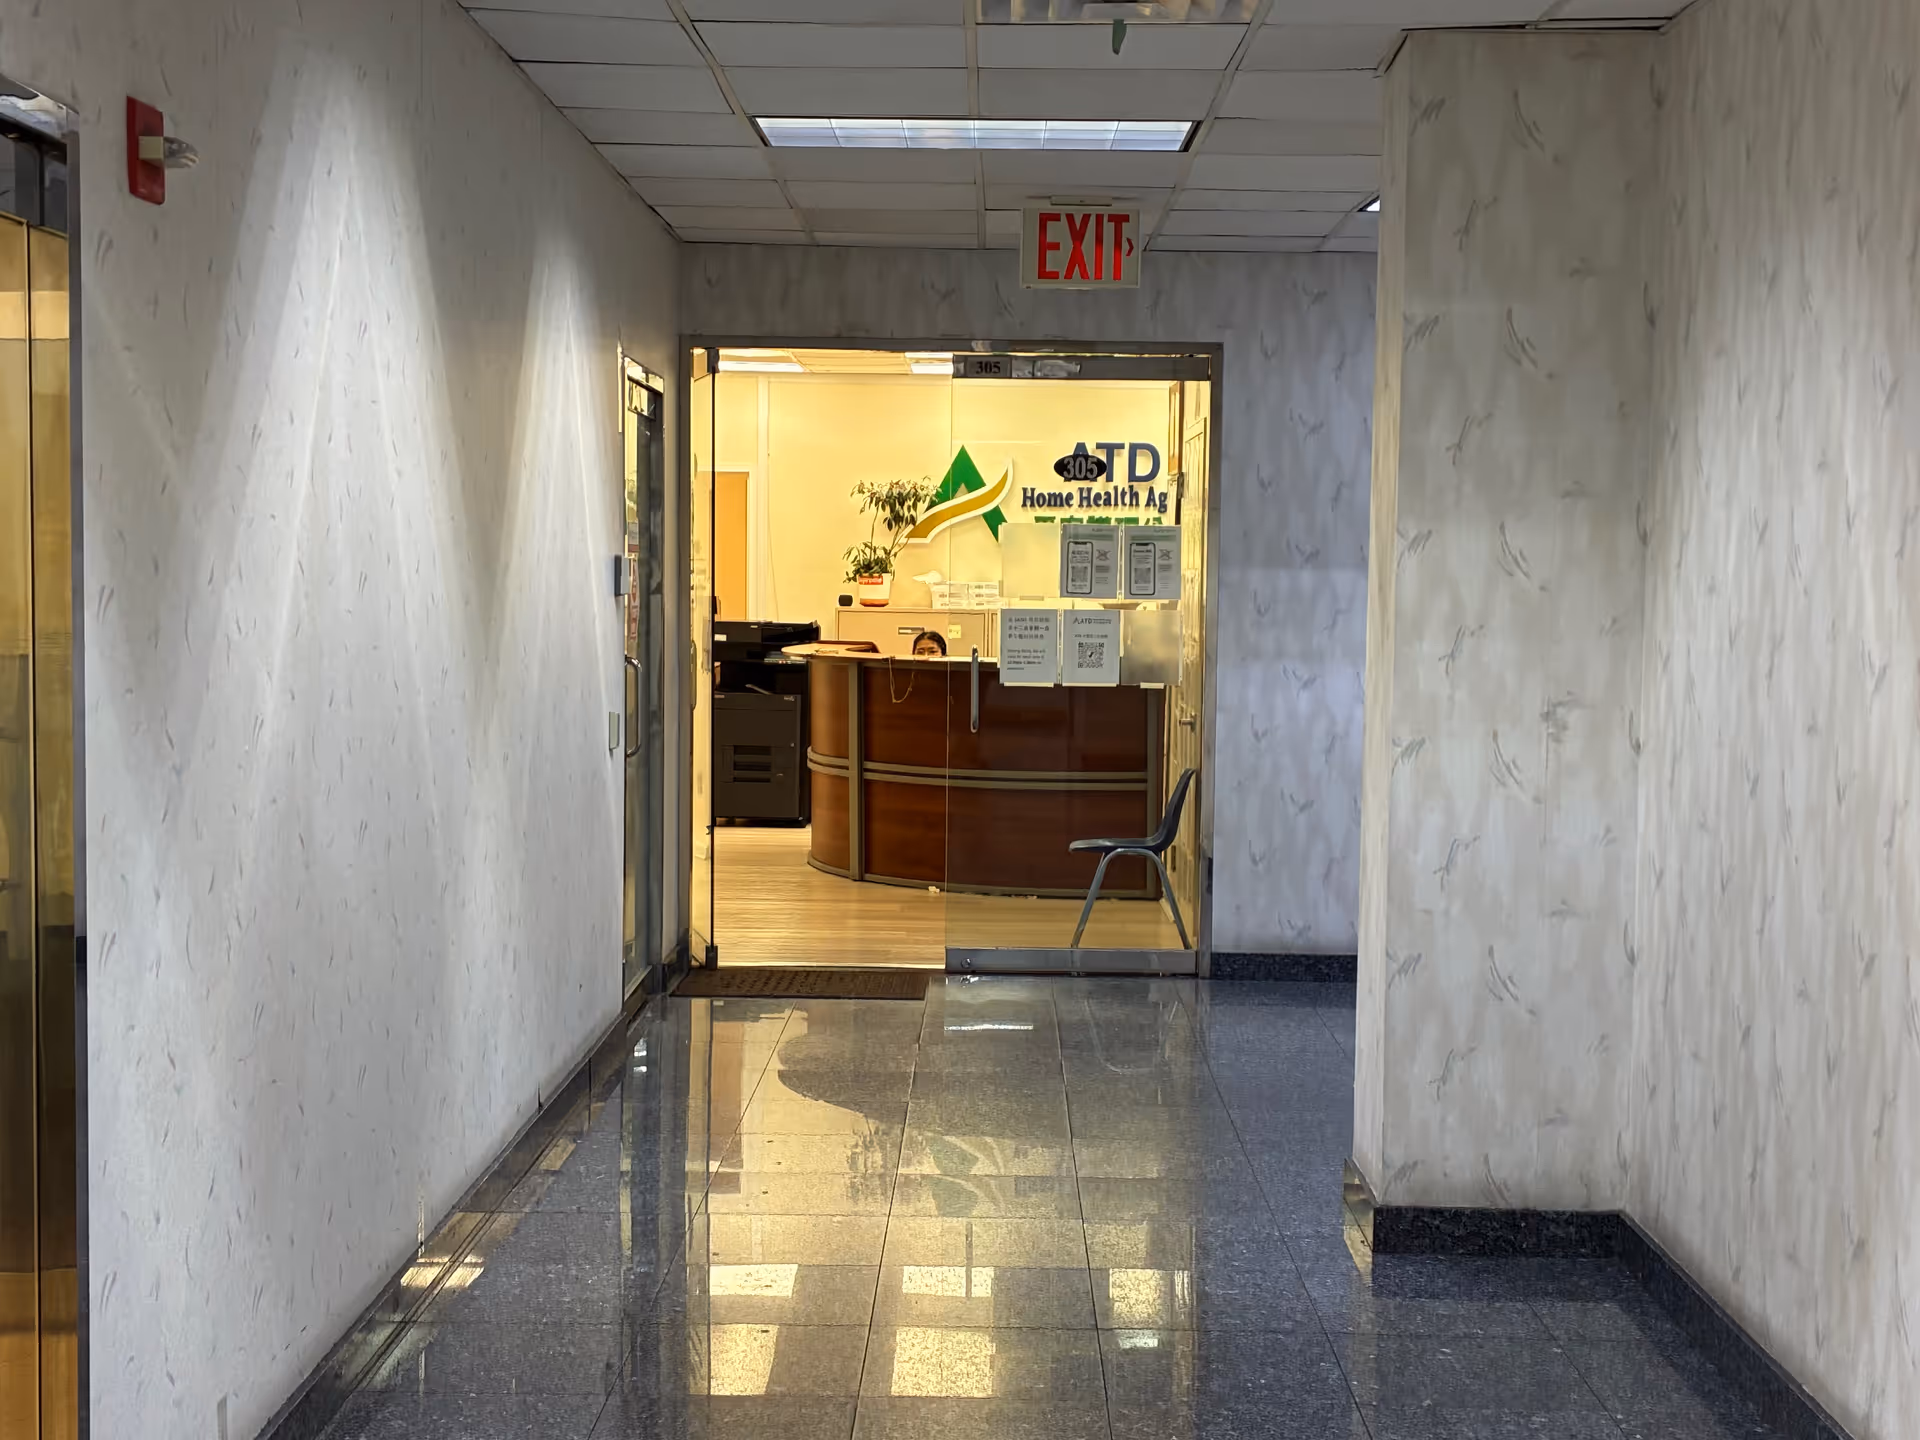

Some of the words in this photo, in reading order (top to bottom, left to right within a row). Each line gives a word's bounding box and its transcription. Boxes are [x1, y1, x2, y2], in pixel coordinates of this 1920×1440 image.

[1038, 212, 1130, 281] EXIT
[975, 360, 1001, 375] 305
[1063, 457, 1098, 479] 305
[1021, 487, 1074, 508] Home
[1078, 485, 1140, 508] Health
